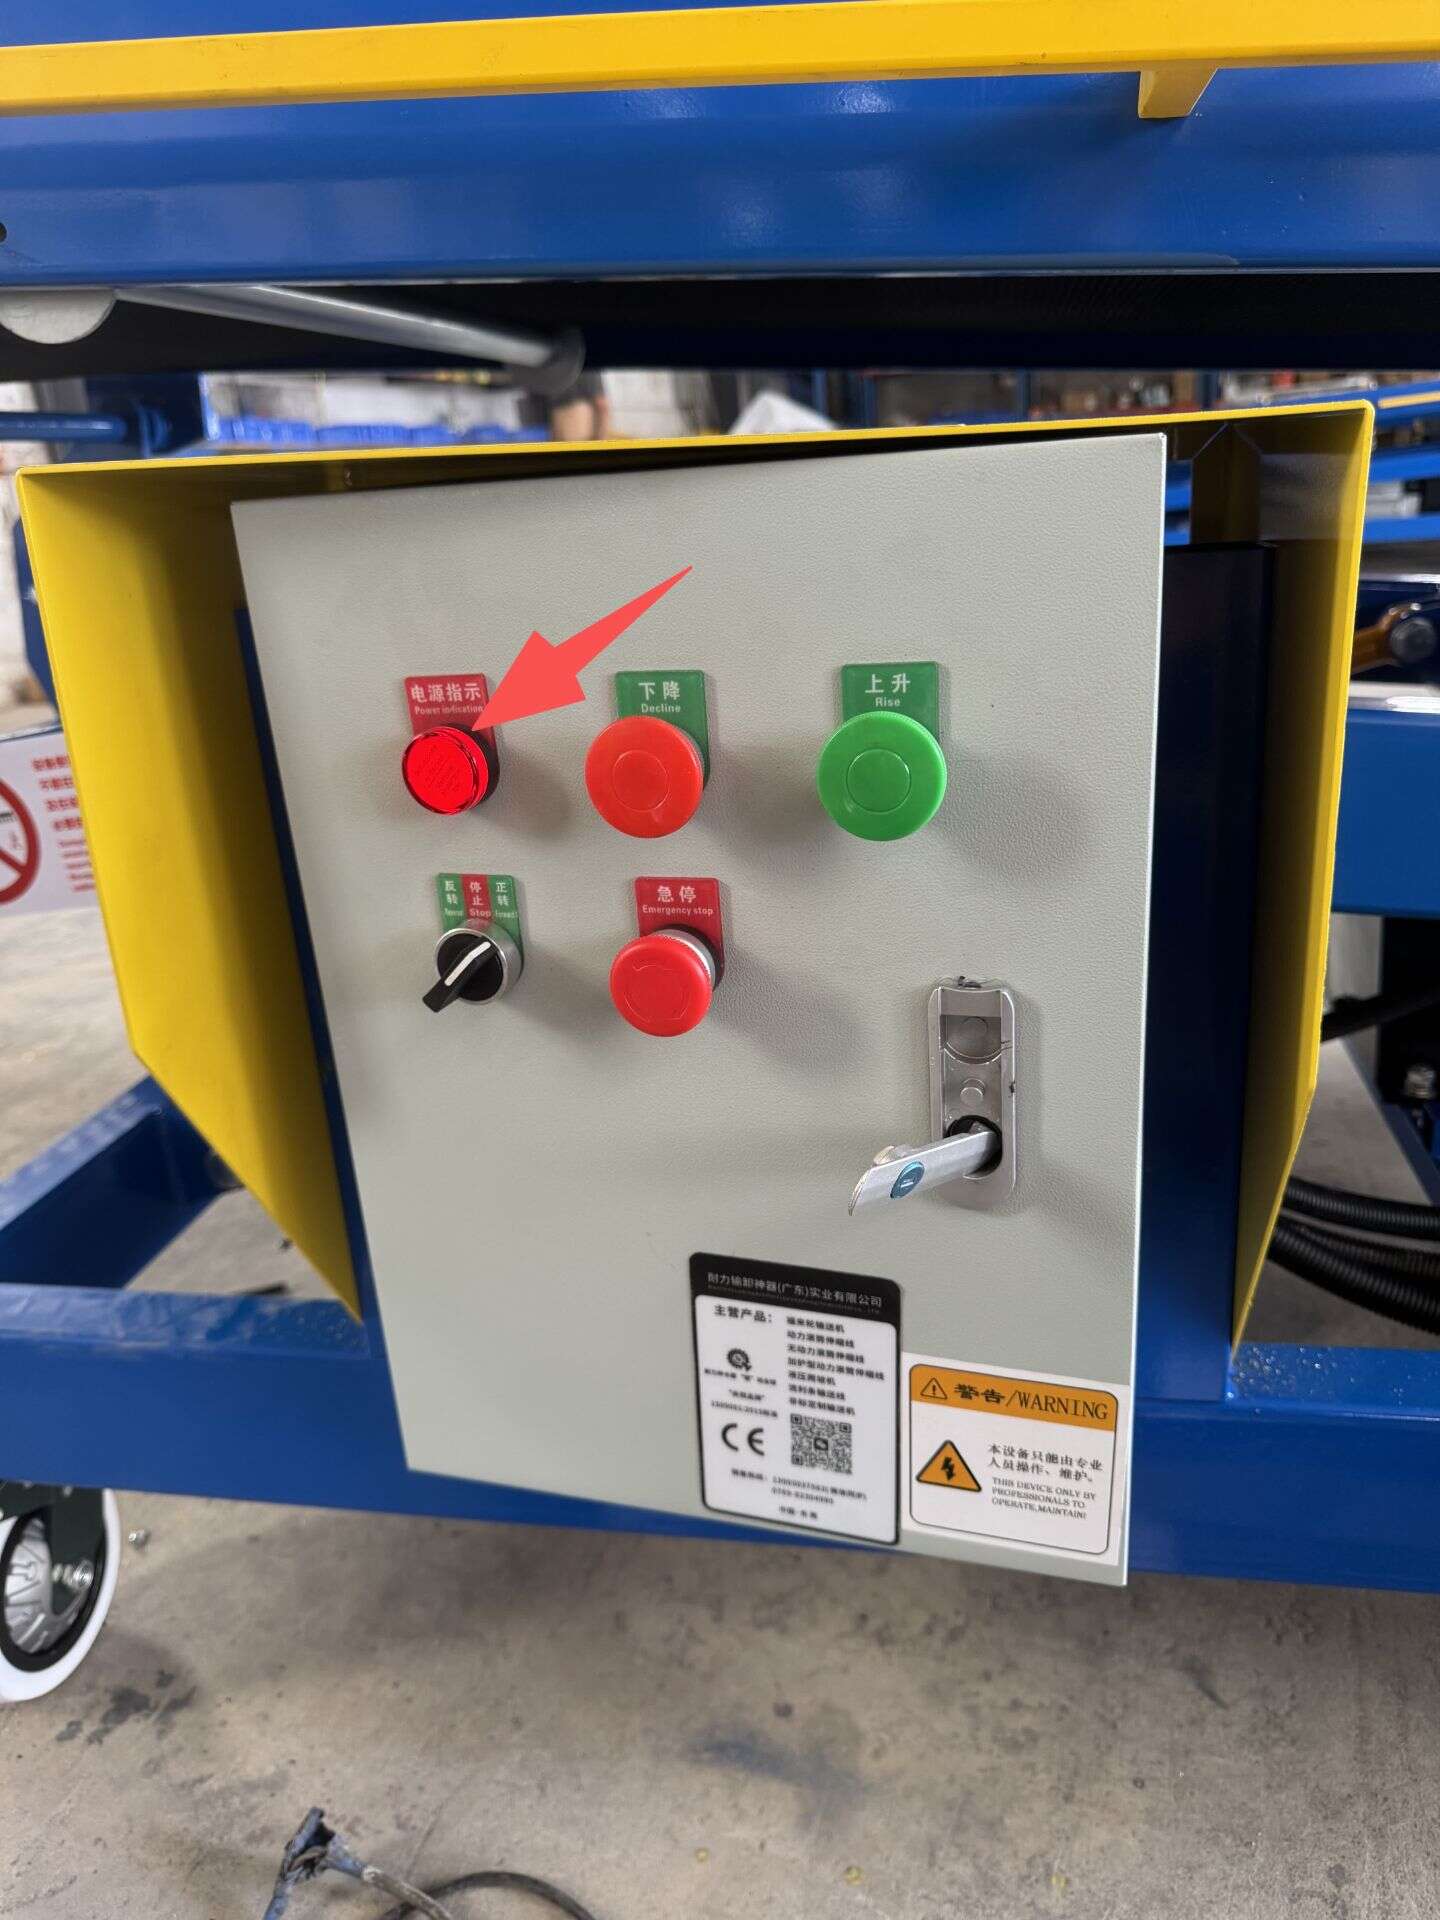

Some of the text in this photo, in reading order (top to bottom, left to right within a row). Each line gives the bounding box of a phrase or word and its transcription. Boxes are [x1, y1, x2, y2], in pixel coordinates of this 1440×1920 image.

[411, 682, 482, 703] 电源指示
[638, 681, 681, 701] 下降
[865, 673, 911, 694] 上升
[415, 706, 441, 715] Power
[640, 703, 682, 713] Decline
[875, 697, 901, 707] Rise
[469, 881, 484, 906] 停止
[495, 882, 511, 906] 正转
[656, 885, 696, 903] 急停
[469, 908, 492, 918] Stop
[642, 905, 714, 916] Emergency stop
[954, 1383, 1108, 1419] 警告/WARNING
[721, 1423, 764, 1456] CE
[988, 1443, 1103, 1471] 本设备只能由专业
[992, 1477, 1097, 1500] THIS DEVICE ONLY BY
[992, 1487, 1086, 1508] PROFESSIONALS TO
